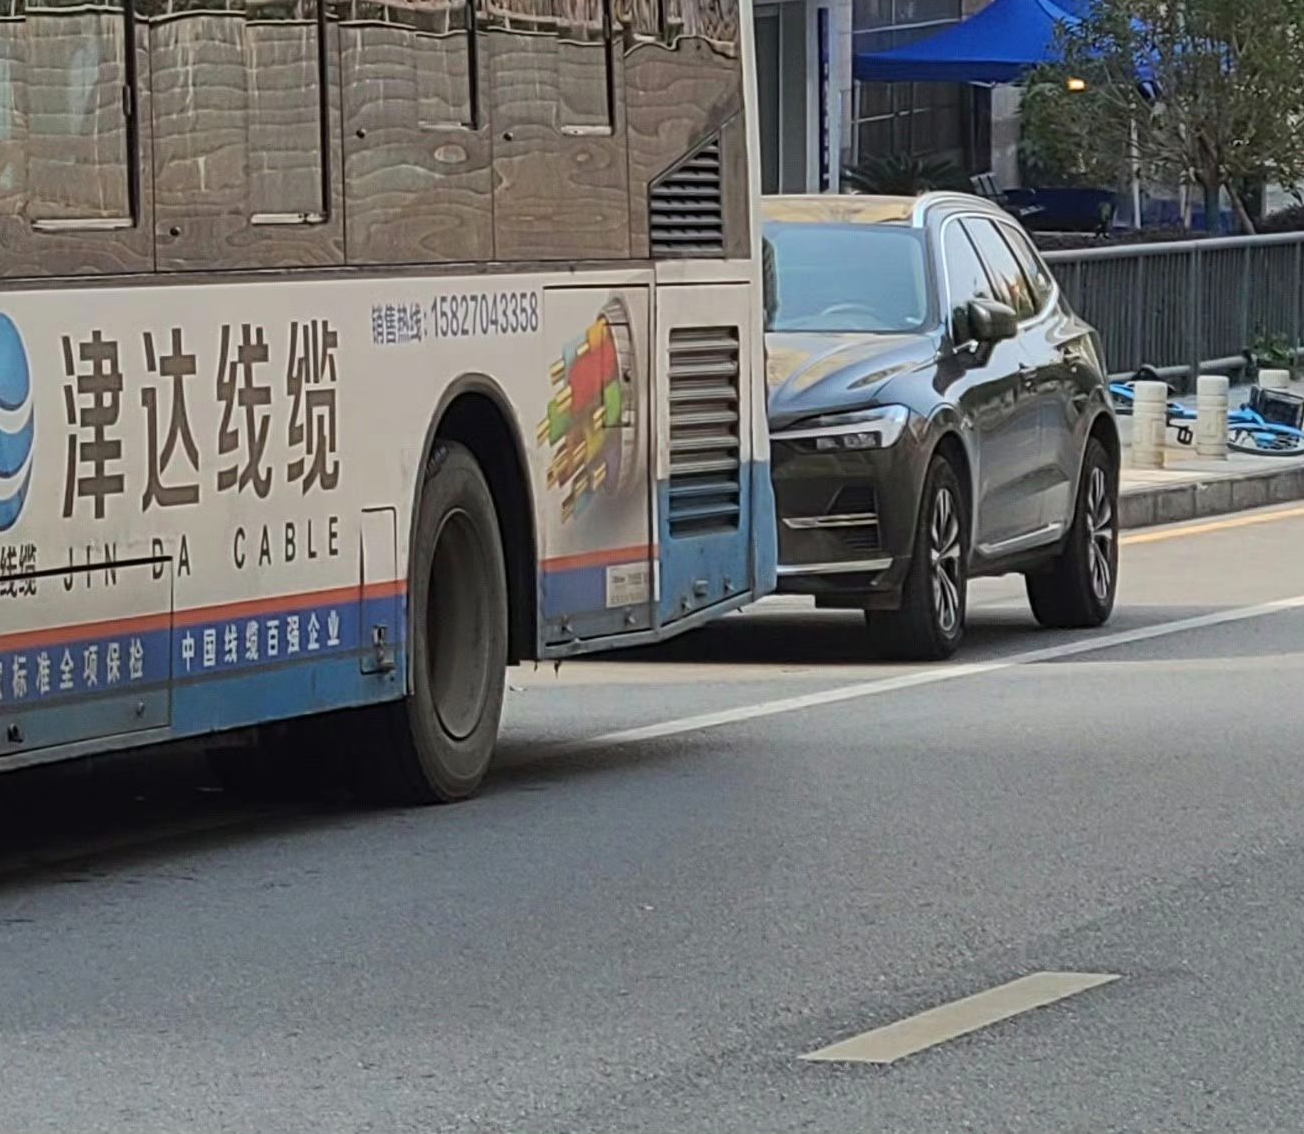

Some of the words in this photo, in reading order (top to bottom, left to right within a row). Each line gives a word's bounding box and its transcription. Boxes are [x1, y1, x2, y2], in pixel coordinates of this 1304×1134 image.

[61, 319, 340, 521] 津达线缆
[63, 543, 117, 592] JIN
[151, 534, 191, 579] DA
[233, 516, 339, 569] CABLE
[181, 610, 342, 673] 中国线缆百强企业
